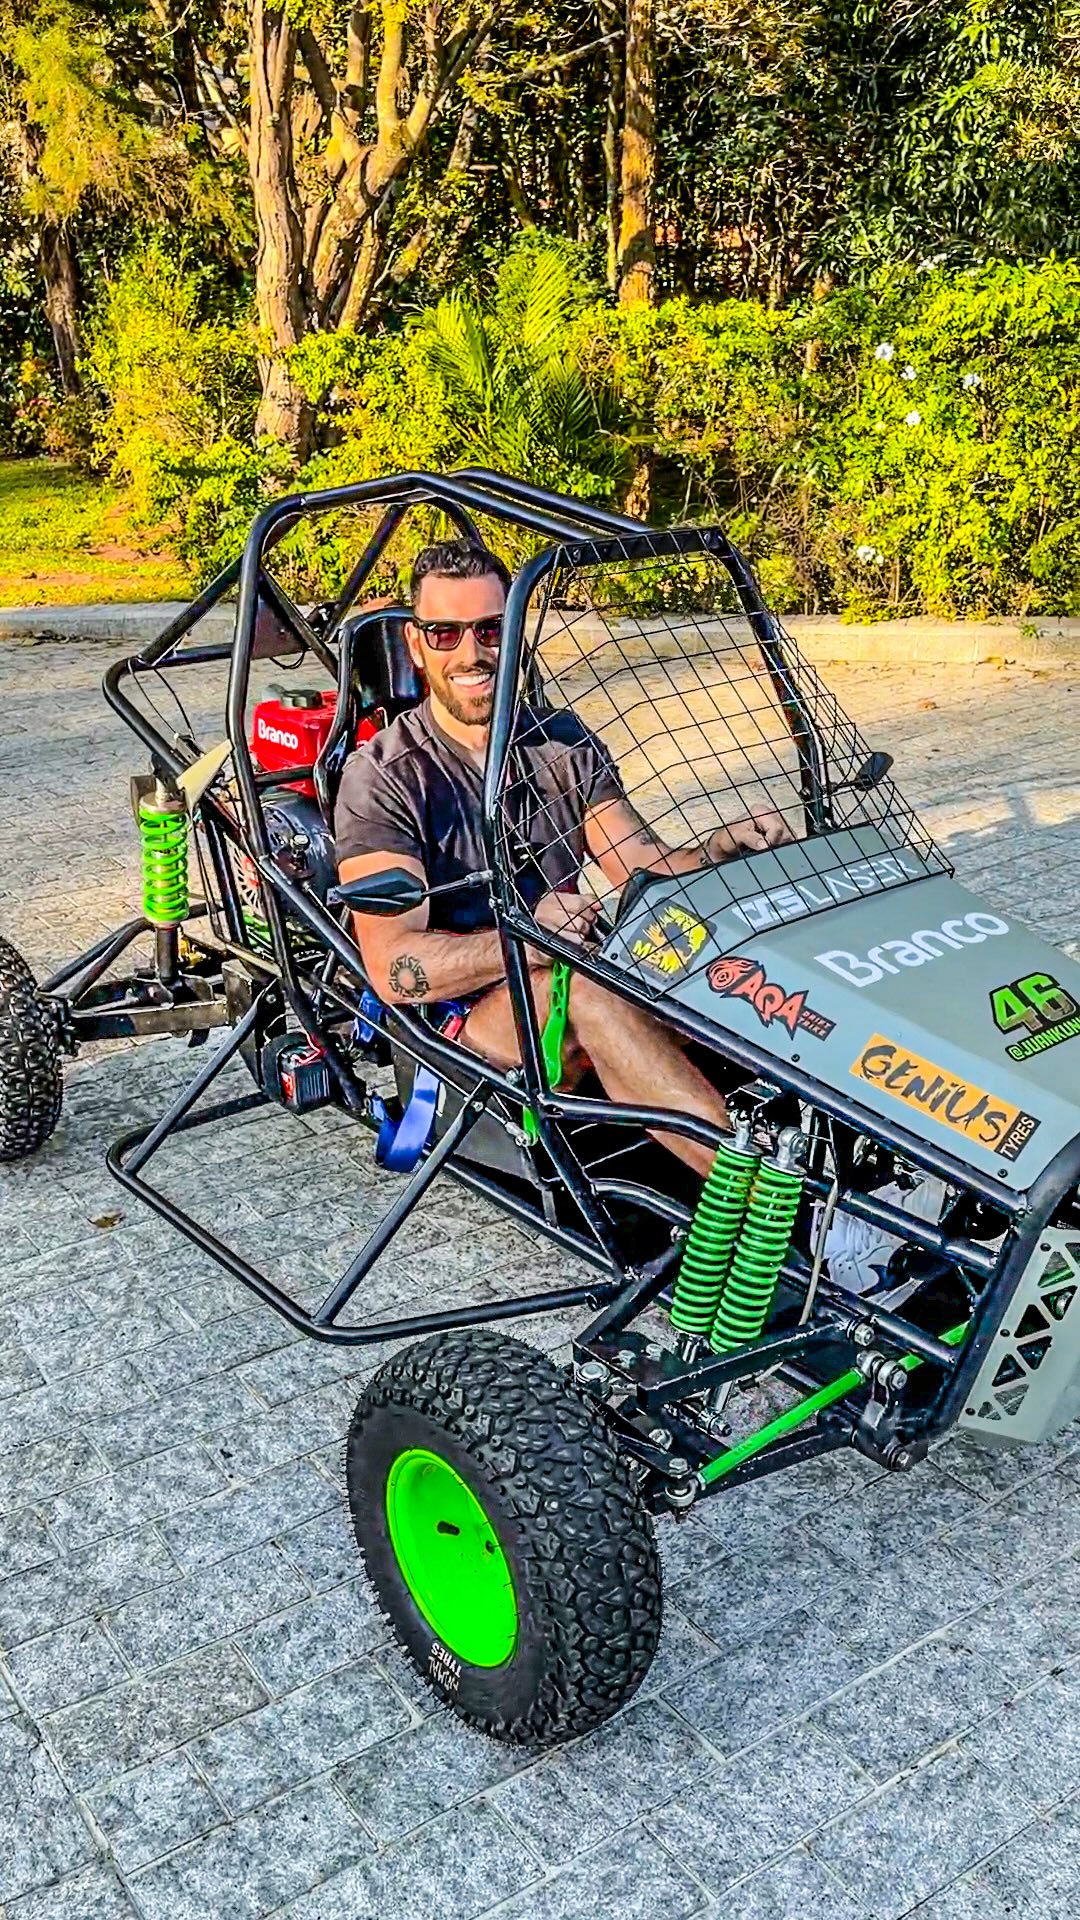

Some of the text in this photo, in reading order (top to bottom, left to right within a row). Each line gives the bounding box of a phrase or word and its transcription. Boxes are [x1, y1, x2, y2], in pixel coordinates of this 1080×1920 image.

[257, 717, 299, 750] Branco
[798, 857, 919, 905] LASER
[813, 912, 1010, 988] Branco
[802, 1010, 832, 1029] DRIFT
[991, 974, 1077, 1031] 46
[798, 1016, 827, 1037] TRIKE
[1008, 1016, 1080, 1061] @JUANKUN
[861, 1044, 1008, 1142] GENIUS
[1000, 1115, 1036, 1159] TYRES
[430, 1642, 462, 1678] TYRES
